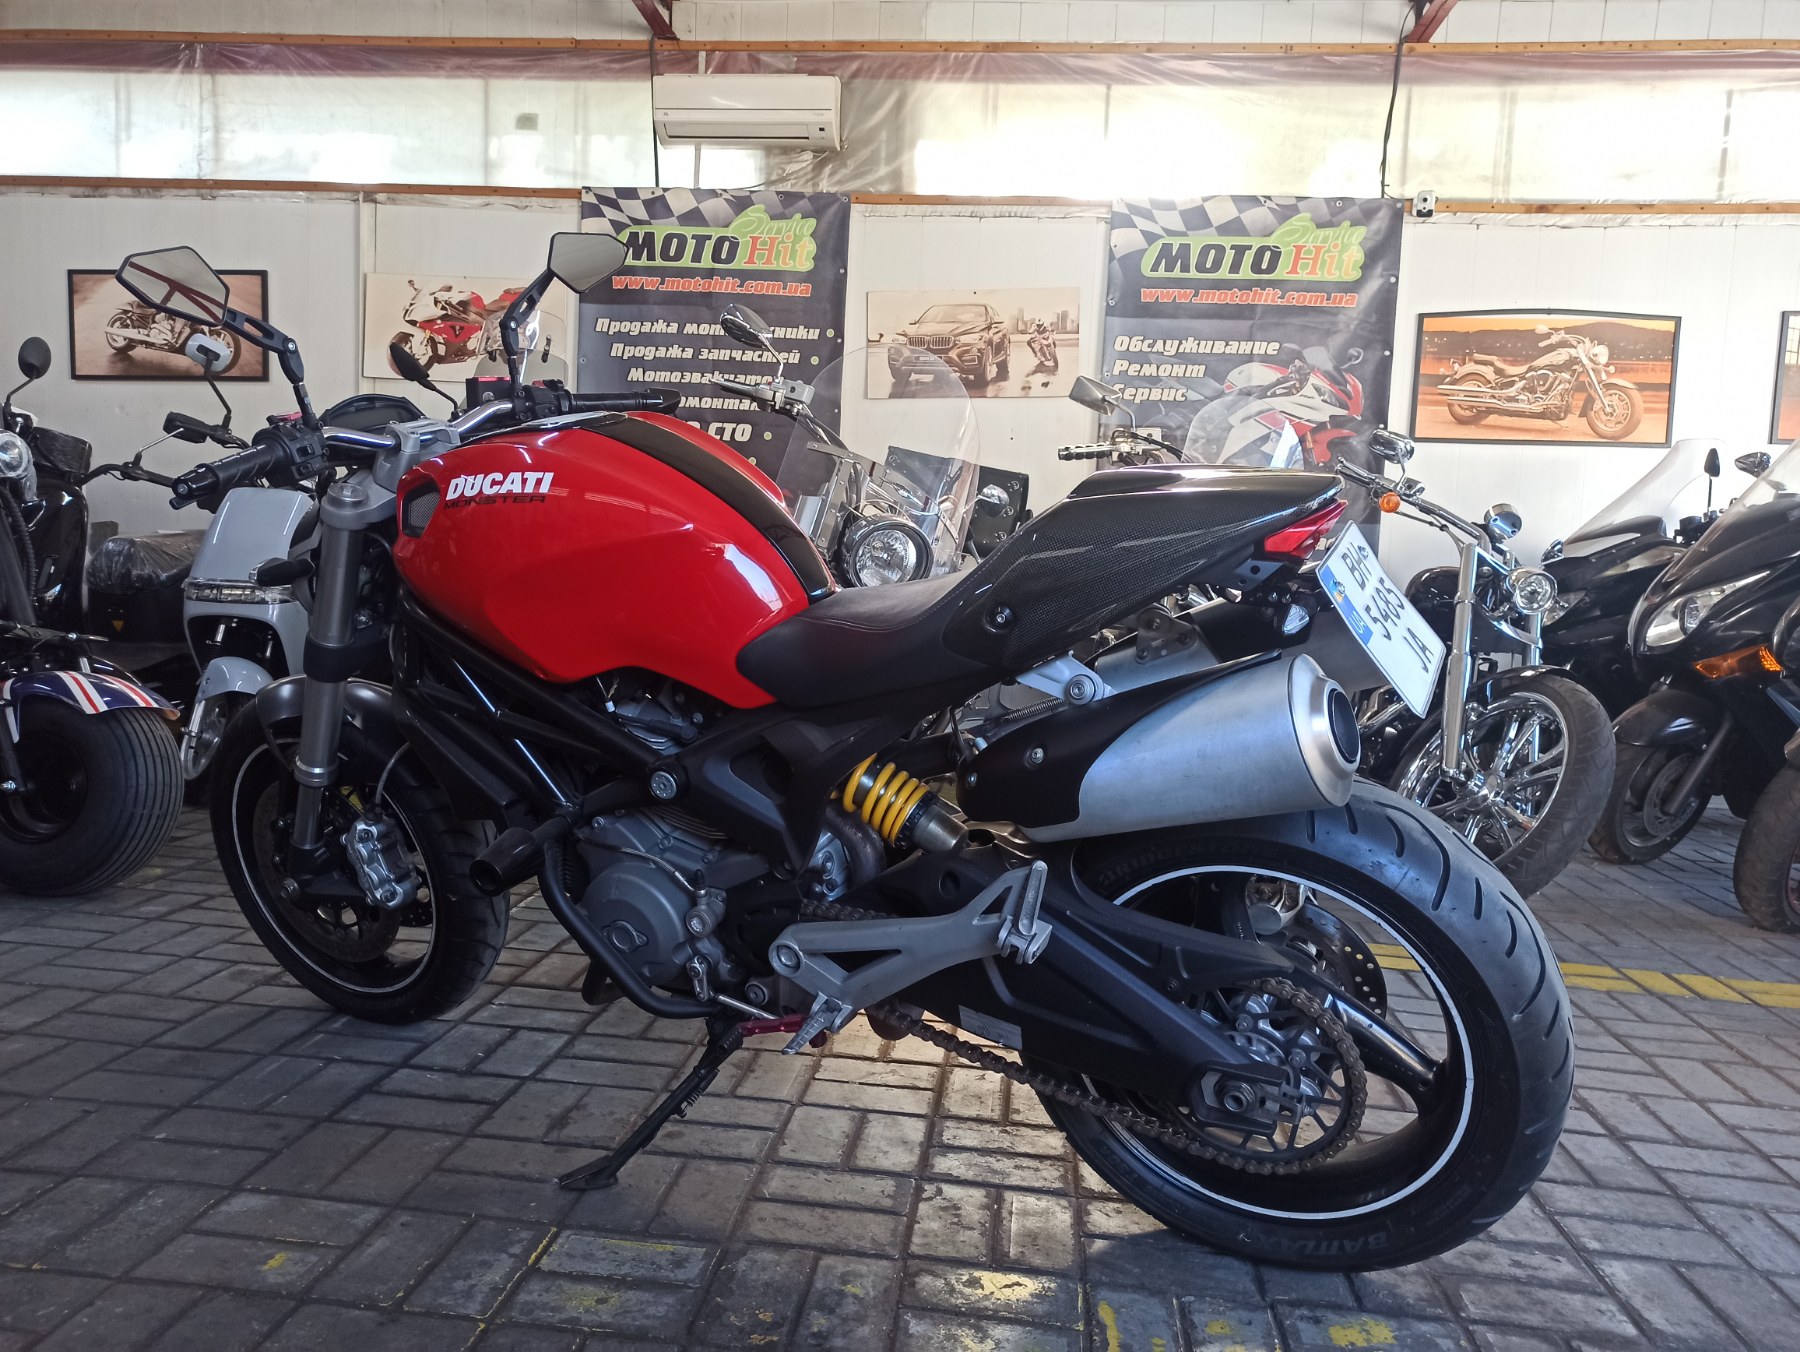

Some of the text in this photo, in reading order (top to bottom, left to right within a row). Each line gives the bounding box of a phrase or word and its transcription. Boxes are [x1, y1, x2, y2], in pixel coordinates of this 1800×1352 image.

[742, 232, 815, 269] Hit
[1149, 241, 1360, 279] MOTO Hit
[611, 275, 812, 297] www.motohit.com.ua
[1140, 288, 1358, 308] www.motohit.com.ua
[595, 318, 679, 336] Продажа
[610, 342, 801, 364] Продажа запчастей
[1113, 335, 1281, 356] Обслуживание
[1112, 359, 1207, 378] Ремонт
[707, 421, 753, 442] СТО
[445, 471, 555, 500] DUCATI
[443, 495, 546, 510] MONSTER
[1364, 577, 1405, 642] 5485
